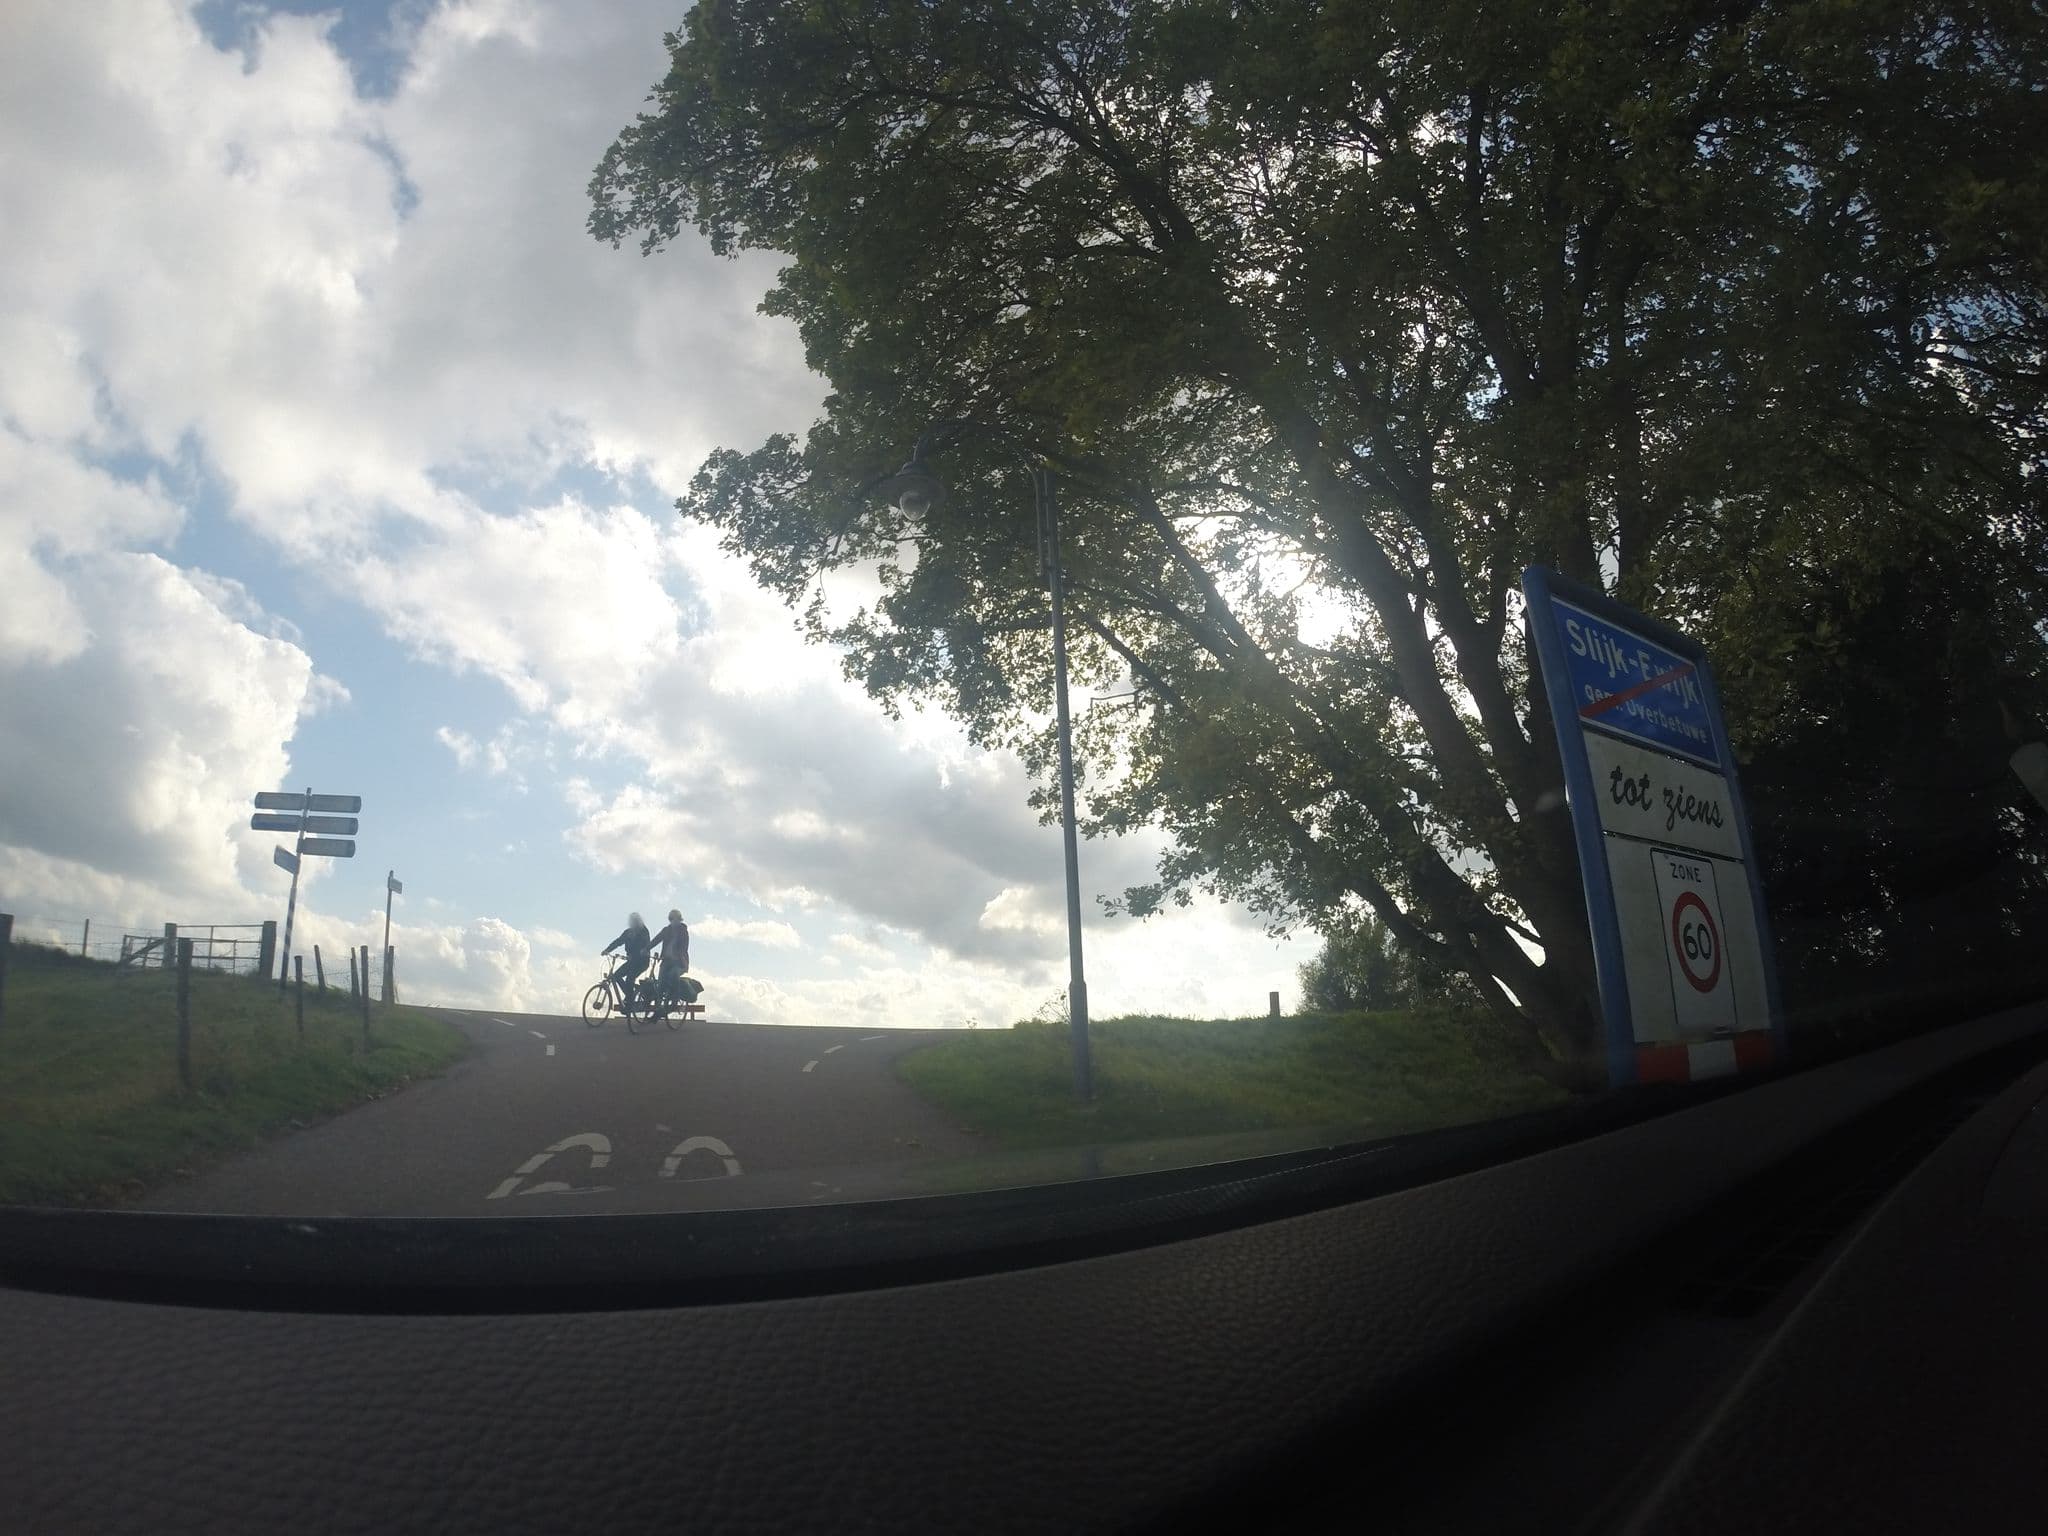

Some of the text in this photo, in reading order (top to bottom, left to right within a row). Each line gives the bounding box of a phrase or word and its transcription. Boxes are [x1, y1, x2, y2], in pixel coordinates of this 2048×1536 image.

[1625, 699, 1708, 744] Overbetuwe
[1610, 766, 1724, 831] tot ziens
[1669, 862, 1702, 884] ZONE
[1682, 921, 1712, 961] 60
